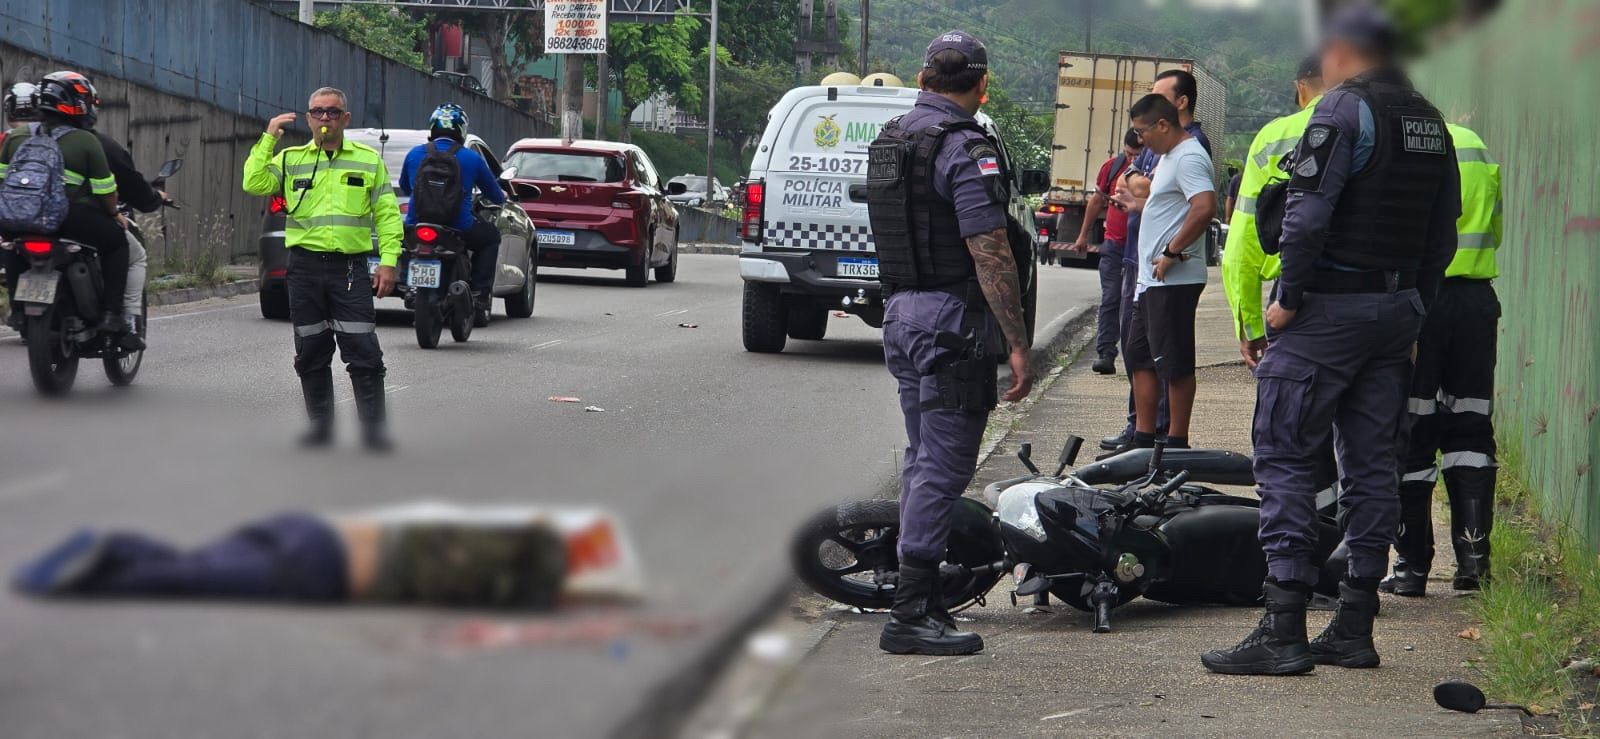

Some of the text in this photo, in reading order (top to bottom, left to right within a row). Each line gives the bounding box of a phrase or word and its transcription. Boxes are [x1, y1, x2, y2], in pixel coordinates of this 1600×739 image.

[845, 121, 884, 142] AMA
[1405, 120, 1442, 136] POLÍCIA
[1407, 136, 1443, 150] MILITAR
[783, 177, 843, 194] POLÍCIA
[782, 192, 843, 208] MILITAR
